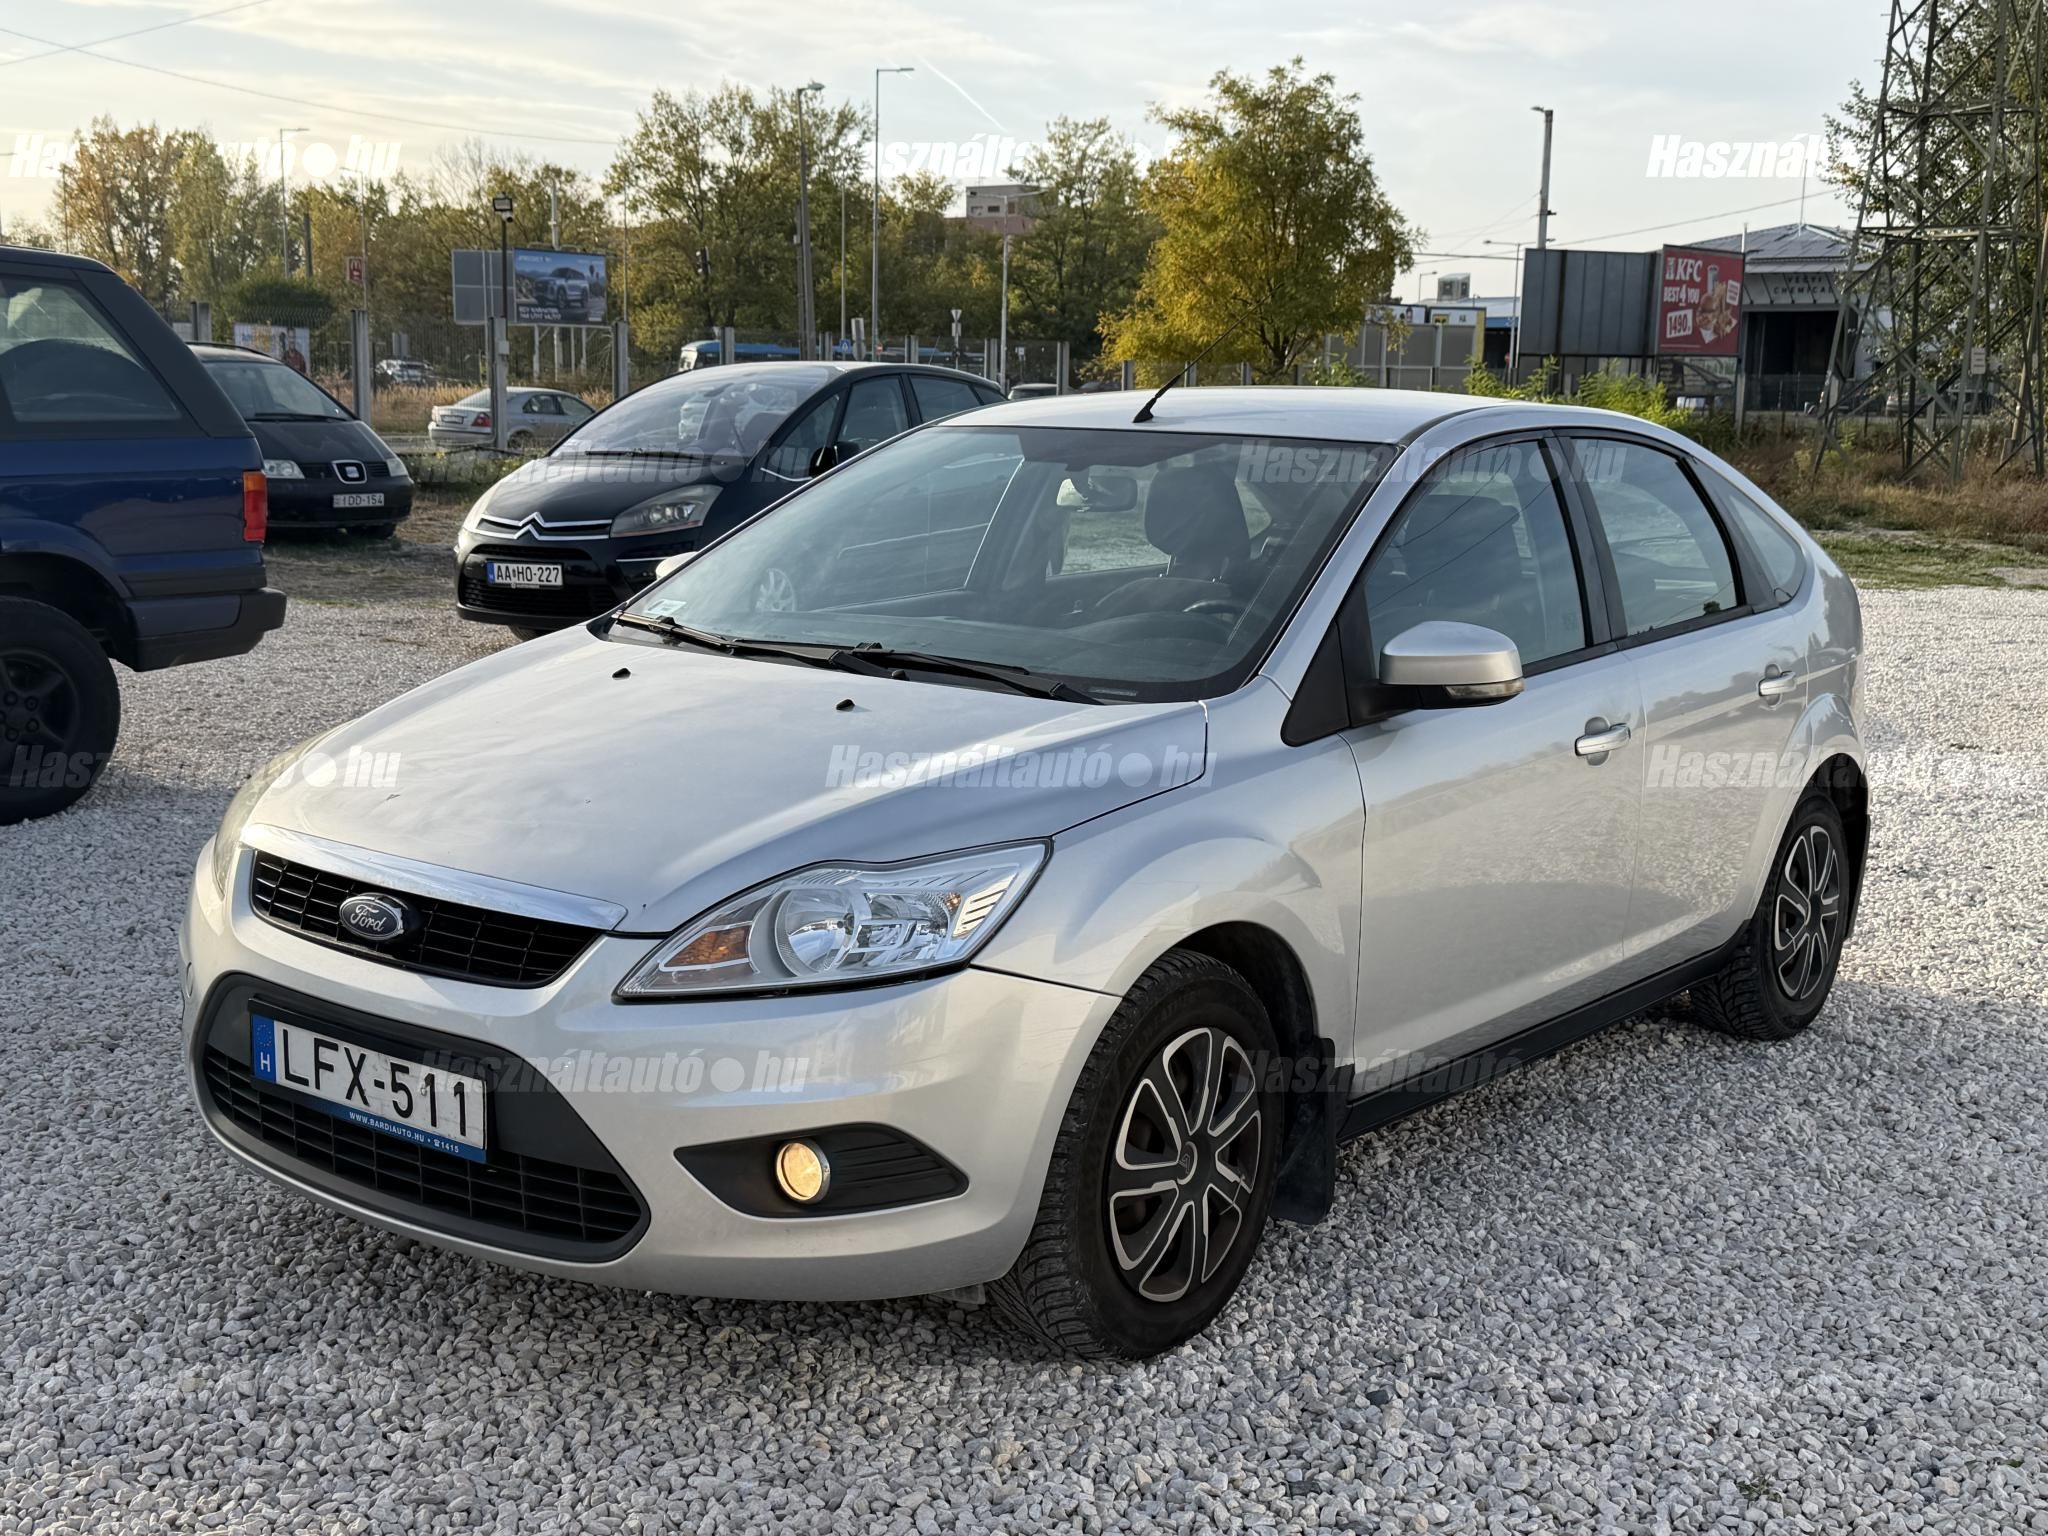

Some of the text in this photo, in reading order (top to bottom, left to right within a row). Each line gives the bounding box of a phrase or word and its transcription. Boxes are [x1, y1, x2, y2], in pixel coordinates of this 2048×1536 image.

[1675, 258, 1703, 283] KFC
[350, 904, 387, 932] Ford
[260, 1051, 271, 1073] H
[282, 1028, 467, 1137] LFX-511
[349, 1111, 425, 1143] WWW.BARDIAUTO.HU
